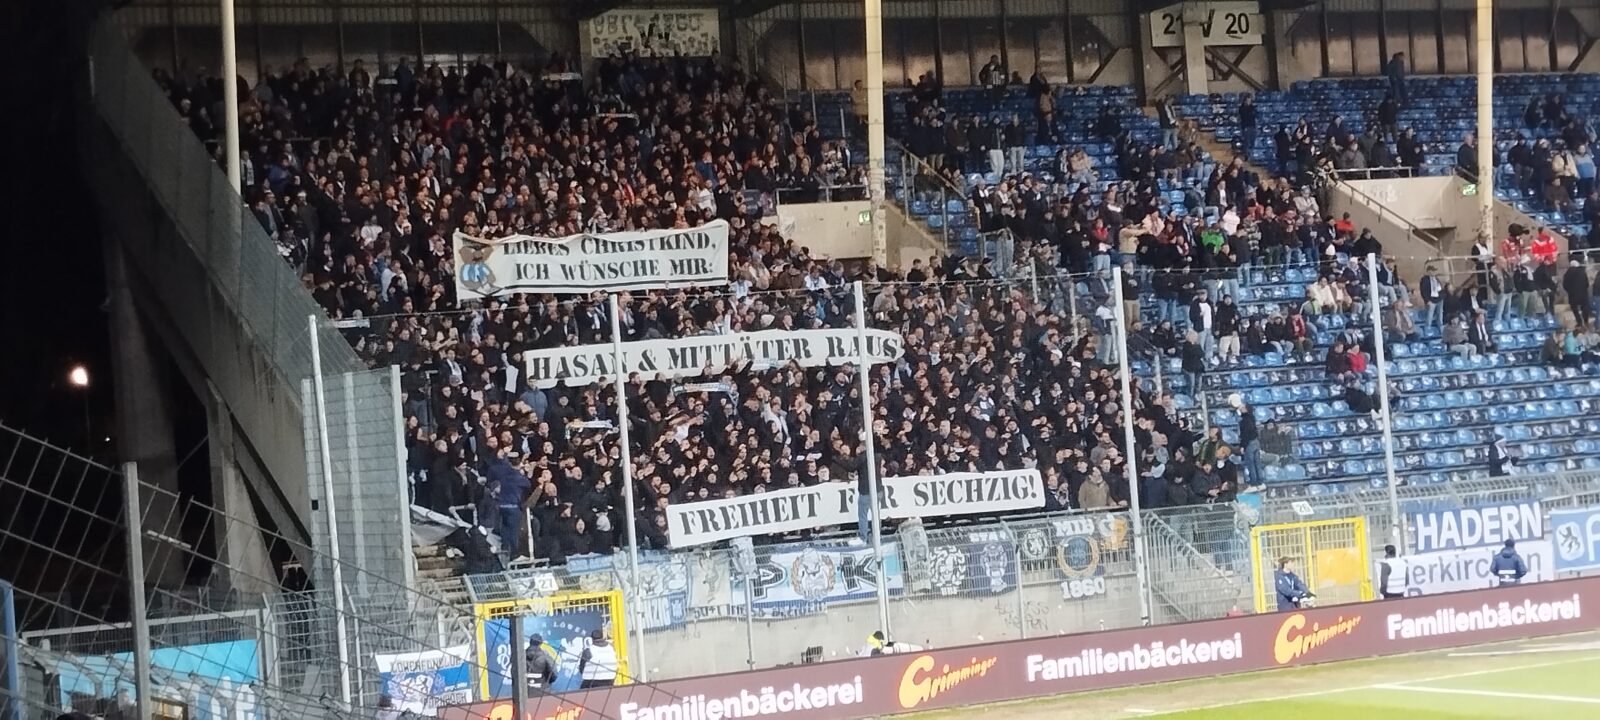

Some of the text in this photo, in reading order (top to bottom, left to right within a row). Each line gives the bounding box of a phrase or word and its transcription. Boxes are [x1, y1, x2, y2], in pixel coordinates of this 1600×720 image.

[1225, 12, 1249, 35] 20
[515, 258, 713, 281] ICH WÜNSCHE MIR:
[531, 335, 899, 380] HASAN & MITTÄTER RAUS
[679, 475, 1038, 536] FREIHEIT FR SECHZIG!
[1416, 501, 1542, 551] HADERN
[1060, 577, 1105, 599] 1860
[1274, 613, 1362, 665] Grimminger
[1387, 594, 1581, 640] Familienbäckerei
[1027, 632, 1243, 682] Familienbäckerei
[619, 676, 863, 720] Familienbäckerei
[899, 654, 997, 709] Grimminger
